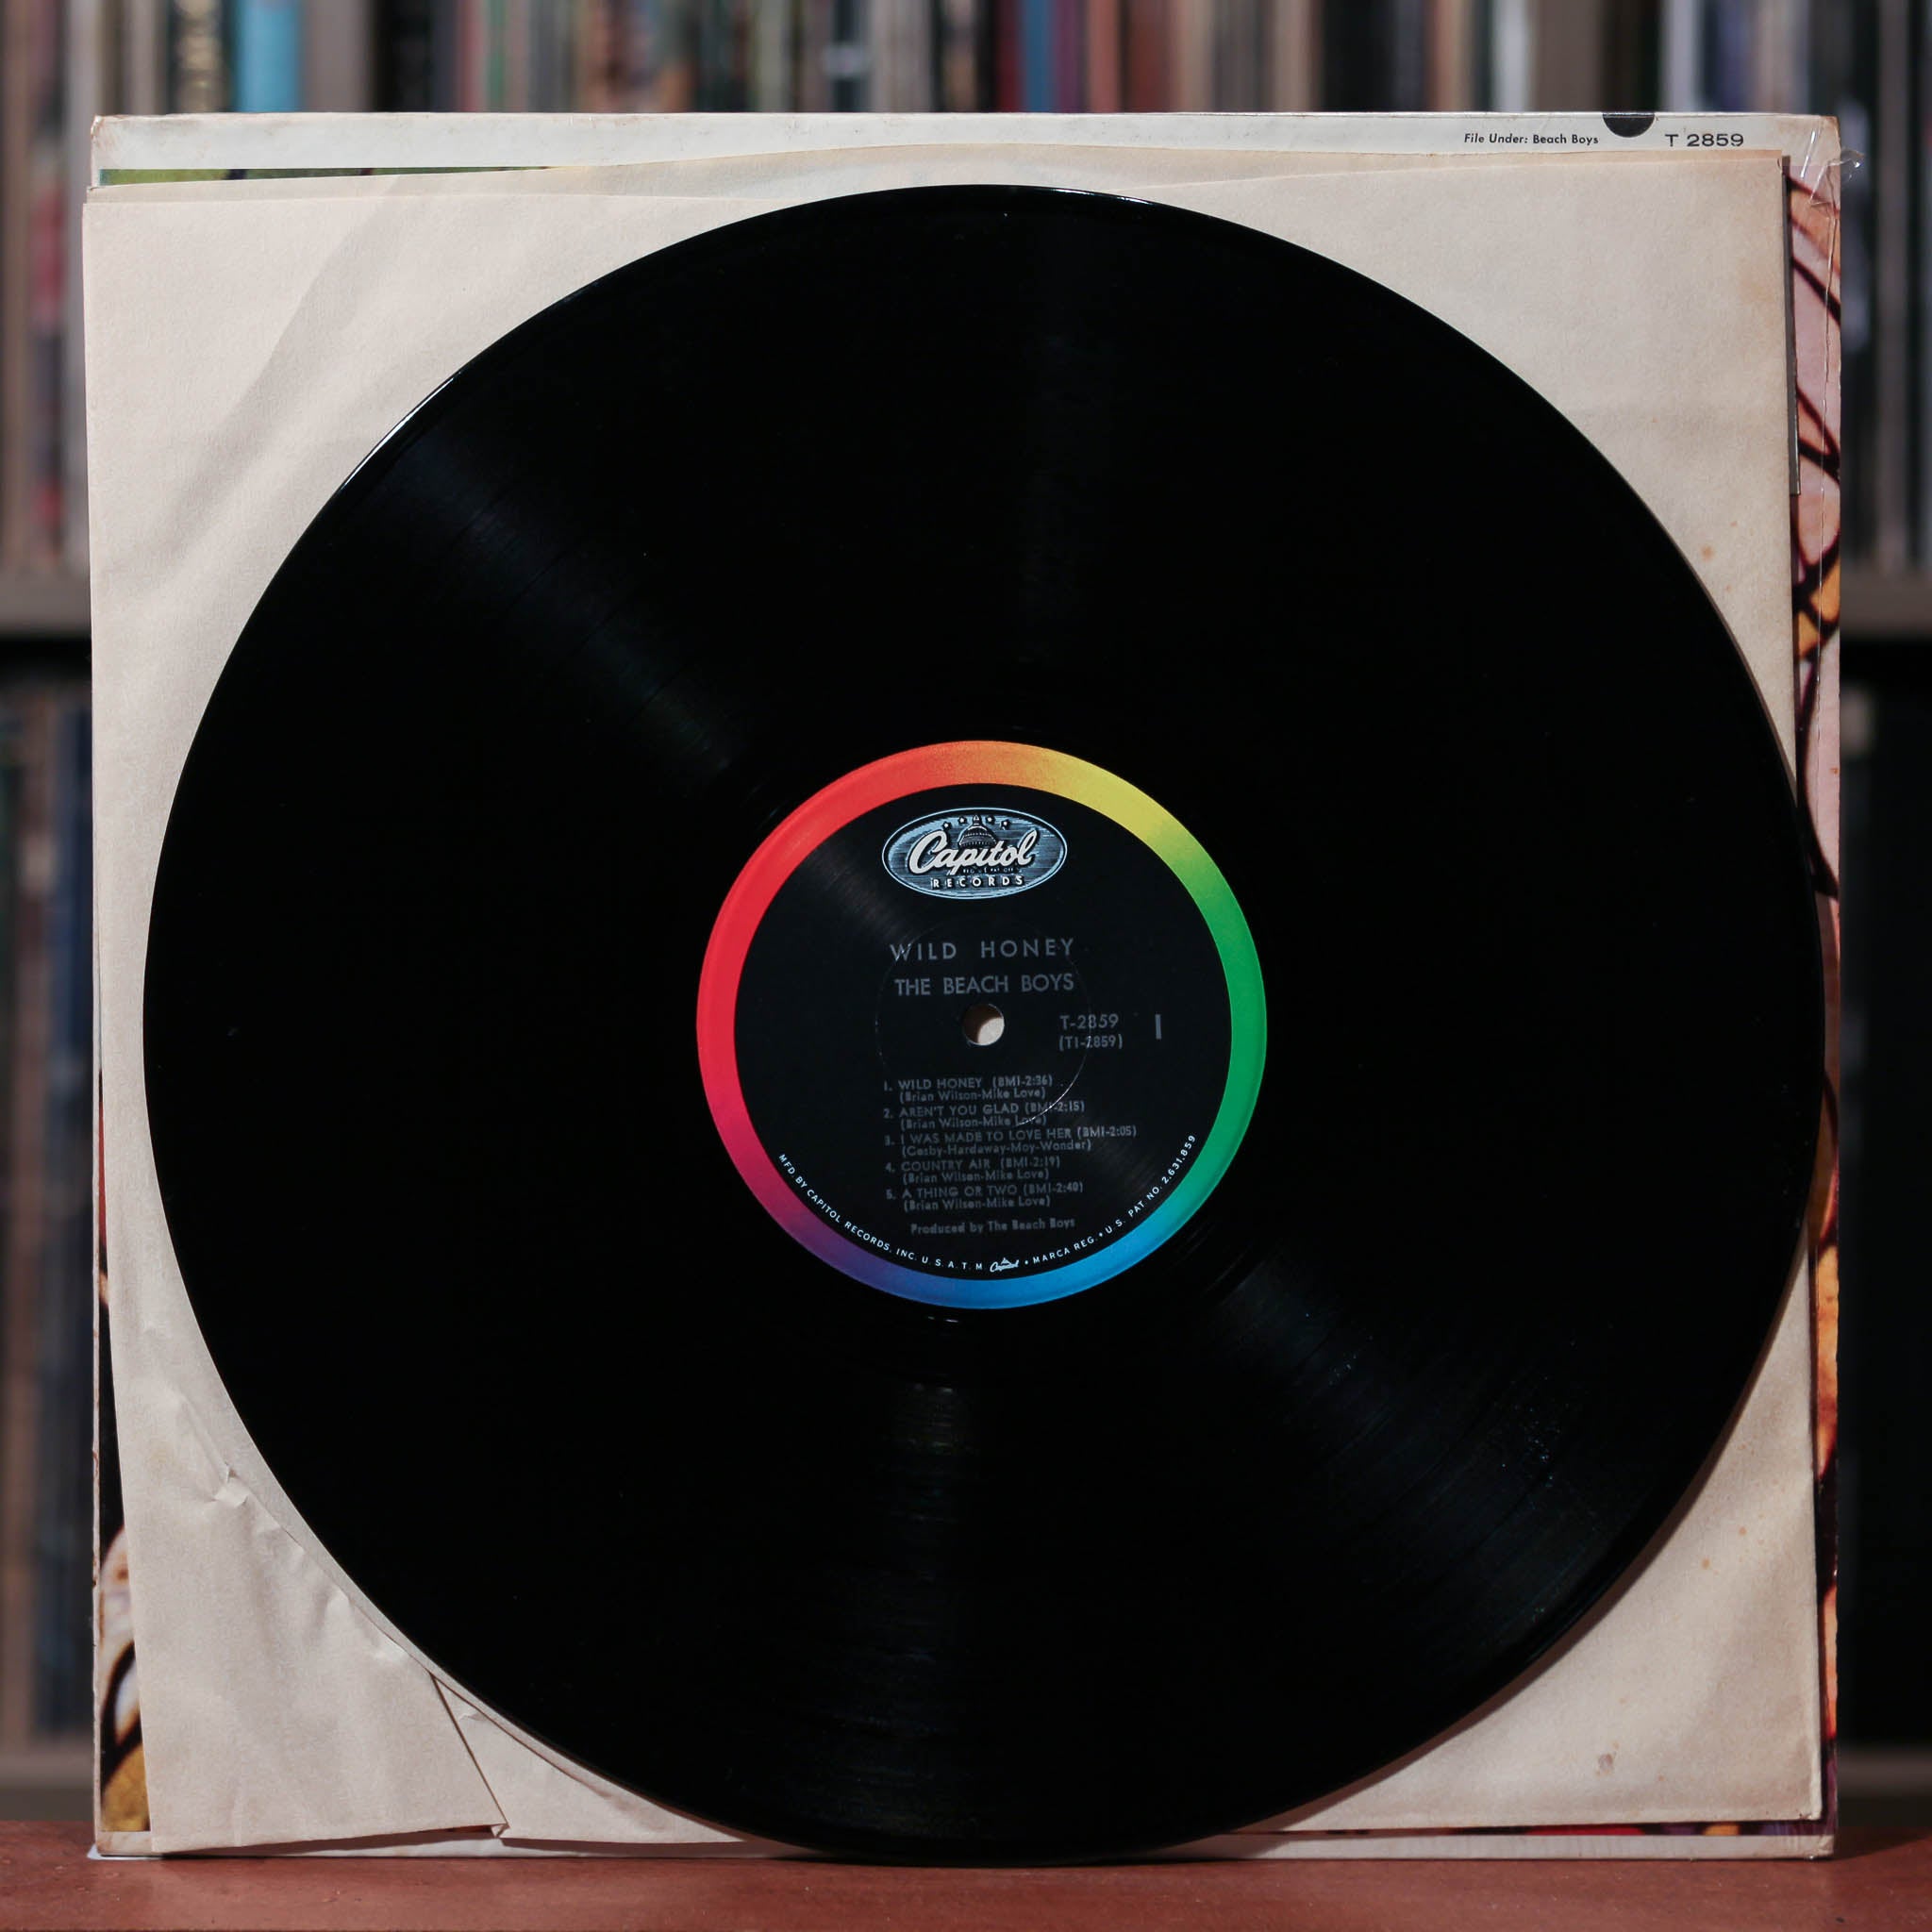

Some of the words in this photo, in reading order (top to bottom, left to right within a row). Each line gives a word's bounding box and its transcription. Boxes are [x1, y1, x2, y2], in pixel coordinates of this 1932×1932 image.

[1464, 133, 1485, 144] File
[1490, 133, 1528, 144] Under:
[1533, 134, 1567, 144] Beach
[1572, 134, 1599, 146] Boys
[1664, 134, 1678, 147] T
[1687, 133, 1744, 147] 2859
[908, 827, 1038, 875] Capitol
[932, 874, 1024, 889] RECORDS
[891, 942, 957, 961] WILD
[981, 938, 1074, 958] HONEY
[894, 977, 931, 996] THE
[943, 974, 1008, 995] BEACH
[1021, 973, 1074, 992] BOYS
[1059, 1013, 1119, 1030] T-2859
[898, 1078, 932, 1091] WILD
[937, 1076, 982, 1089] HONEY
[899, 1091, 935, 1104] (Brian
[938, 1089, 1010, 1101] Wilson-Mike
[1013, 1087, 1046, 1099] Love)
[899, 1106, 944, 1118] AREN'T
[949, 1104, 976, 1116] YOU
[983, 1103, 1019, 1114] GLAD
[901, 1118, 936, 1131] (Brian
[939, 1116, 1011, 1128] Wilson-Mike
[910, 1133, 939, 1144] WAS
[944, 1132, 982, 1143] MADE
[987, 1131, 1004, 1141] TO
[1009, 1129, 1041, 1141] LOVE
[1046, 1127, 1073, 1140] HER
[901, 1159, 963, 1172] COUNTRY
[969, 1158, 991, 1170] AIR
[903, 1172, 938, 1185] (Brian
[1017, 1168, 1049, 1180] Love)
[902, 1189, 912, 1199] A
[917, 1187, 958, 1199] THING
[964, 1186, 982, 1197] OR
[987, 1185, 1017, 1195] TWO
[904, 1199, 939, 1213] (Brian
[1019, 1195, 1051, 1208] Love)
[795, 1175, 808, 1190] BY
[807, 1189, 841, 1223] CAPITOL
[1032, 1247, 1071, 1264] MARCA
[910, 1223, 966, 1236] Produced
[970, 1222, 983, 1234] by
[988, 1219, 1008, 1231] The
[1011, 1218, 1045, 1230] Beach
[1049, 1217, 1076, 1230] Boys
